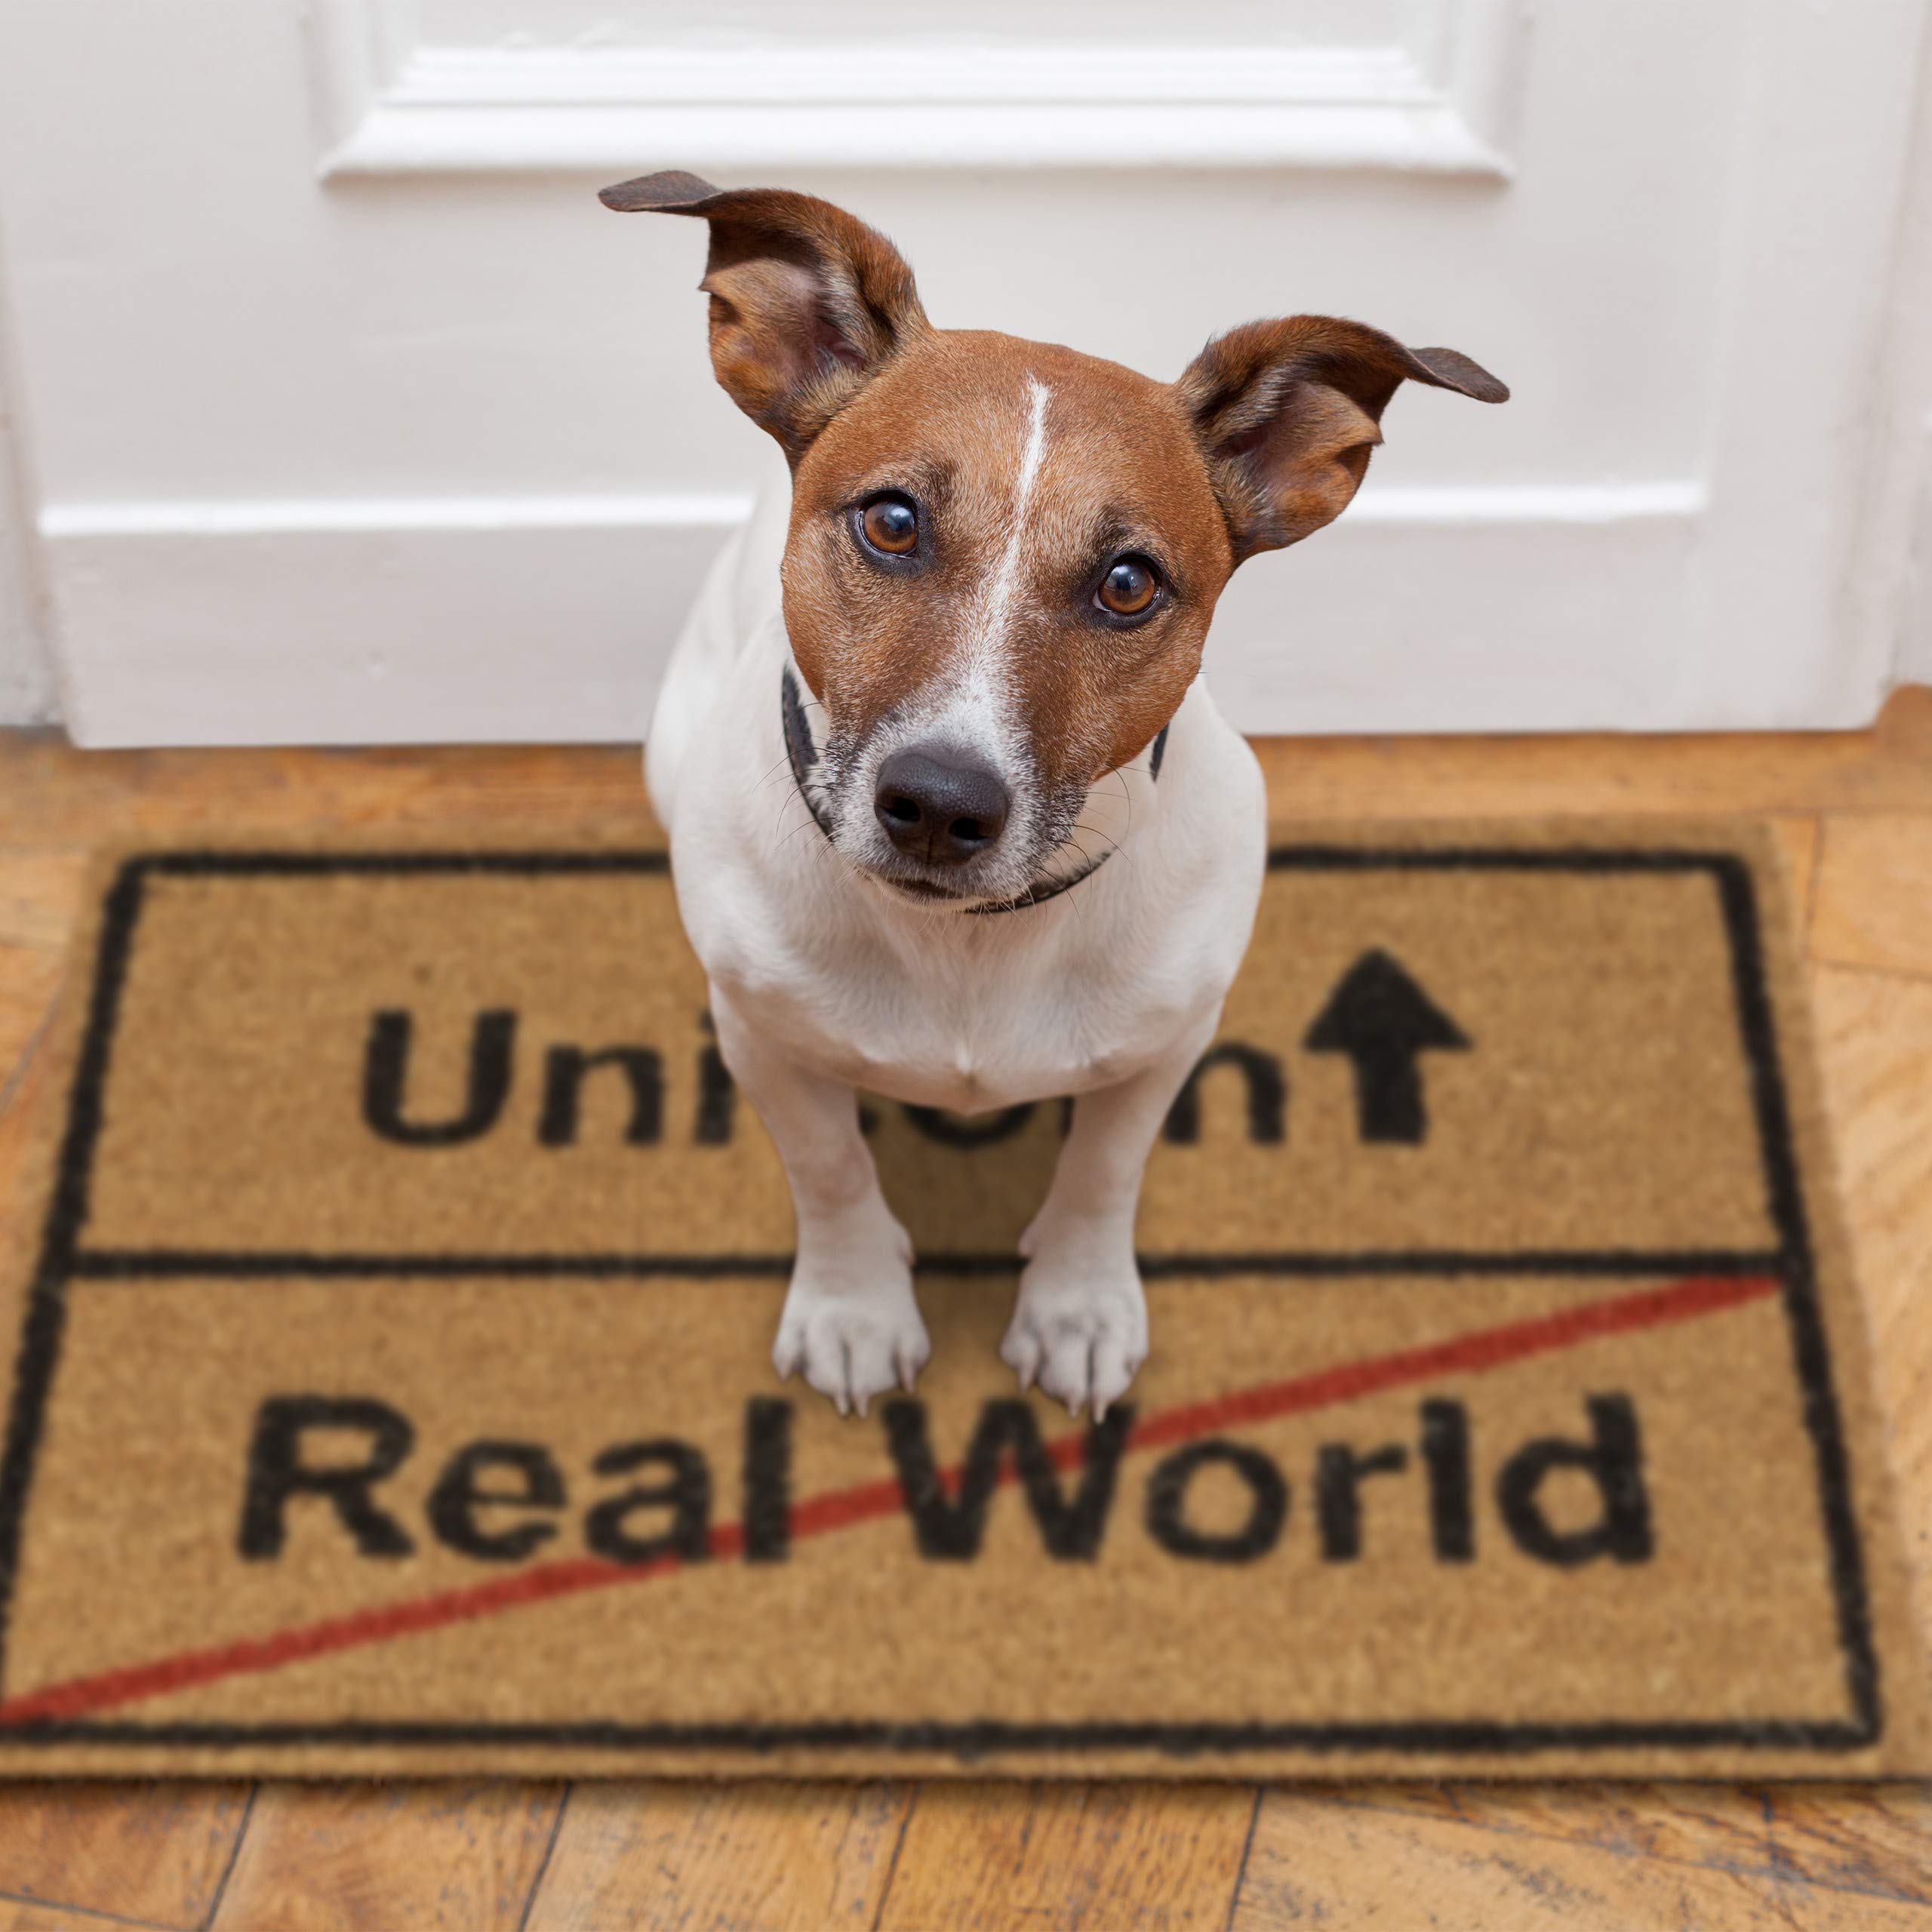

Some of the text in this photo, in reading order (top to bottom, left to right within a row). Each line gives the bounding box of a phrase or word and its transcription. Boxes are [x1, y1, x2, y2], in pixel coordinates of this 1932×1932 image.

[358, 1007, 1289, 1149] Unin
[234, 1392, 1657, 1570] Real World
